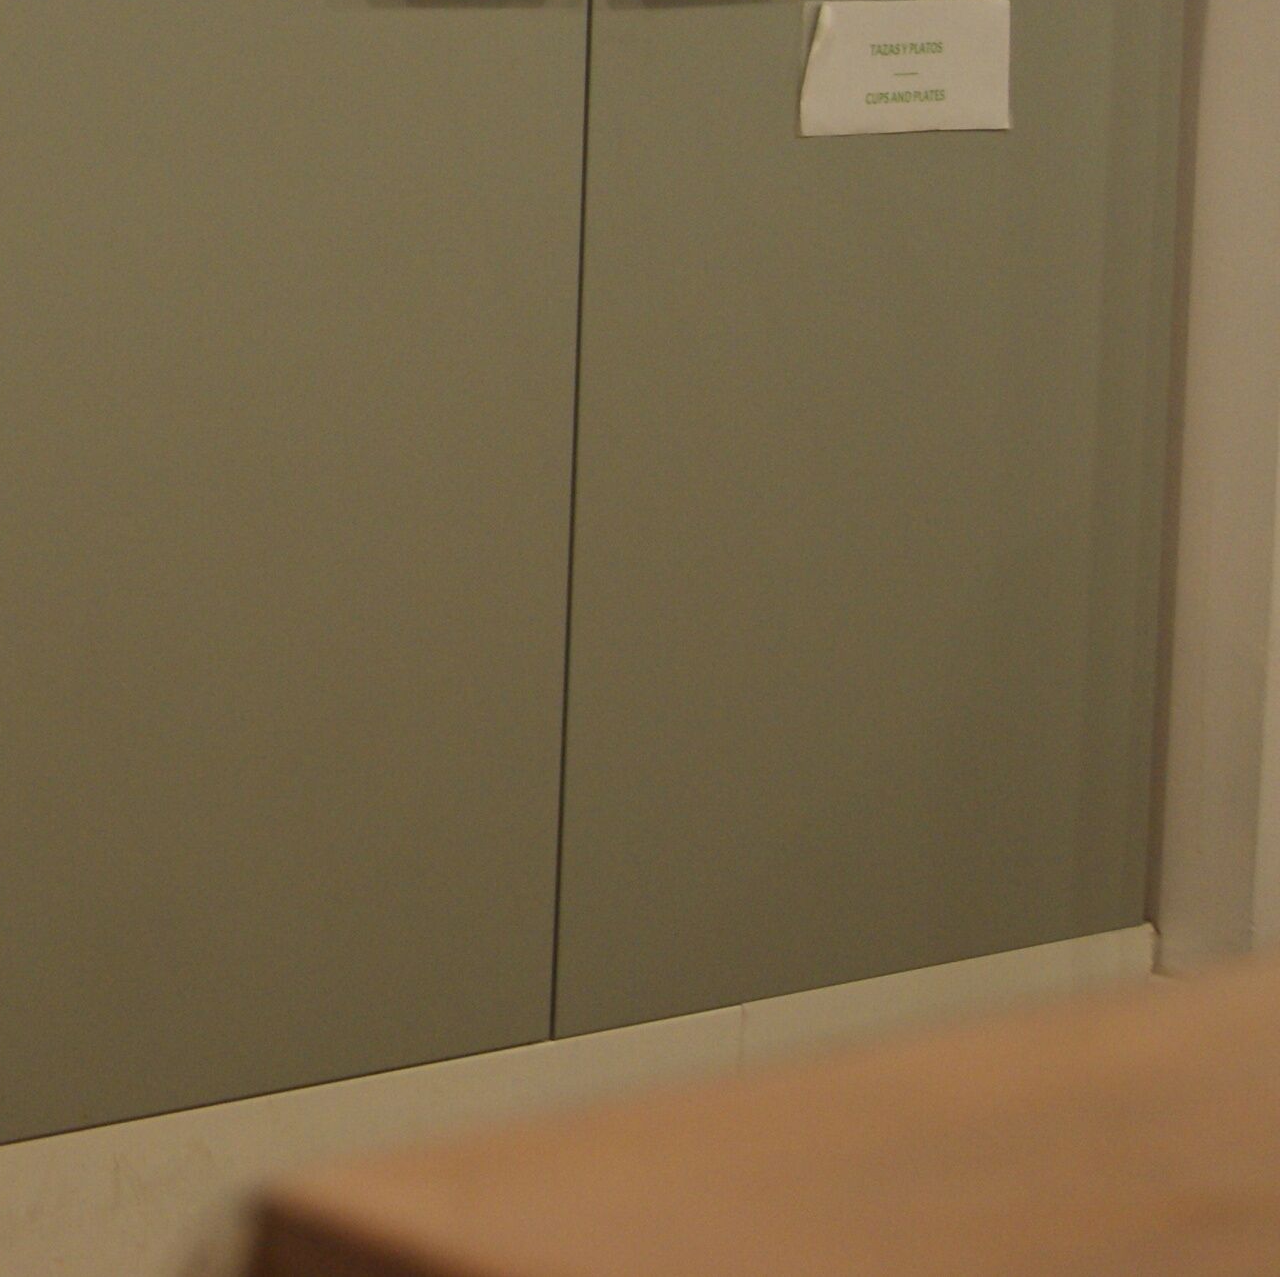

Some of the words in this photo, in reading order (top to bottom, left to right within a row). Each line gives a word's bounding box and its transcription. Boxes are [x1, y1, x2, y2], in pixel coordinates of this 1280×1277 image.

[870, 43, 901, 56] TAZAS
[909, 41, 944, 55] PLATOS
[865, 92, 890, 105] CUPS
[891, 90, 913, 104] AND
[913, 89, 946, 102] PLATES
